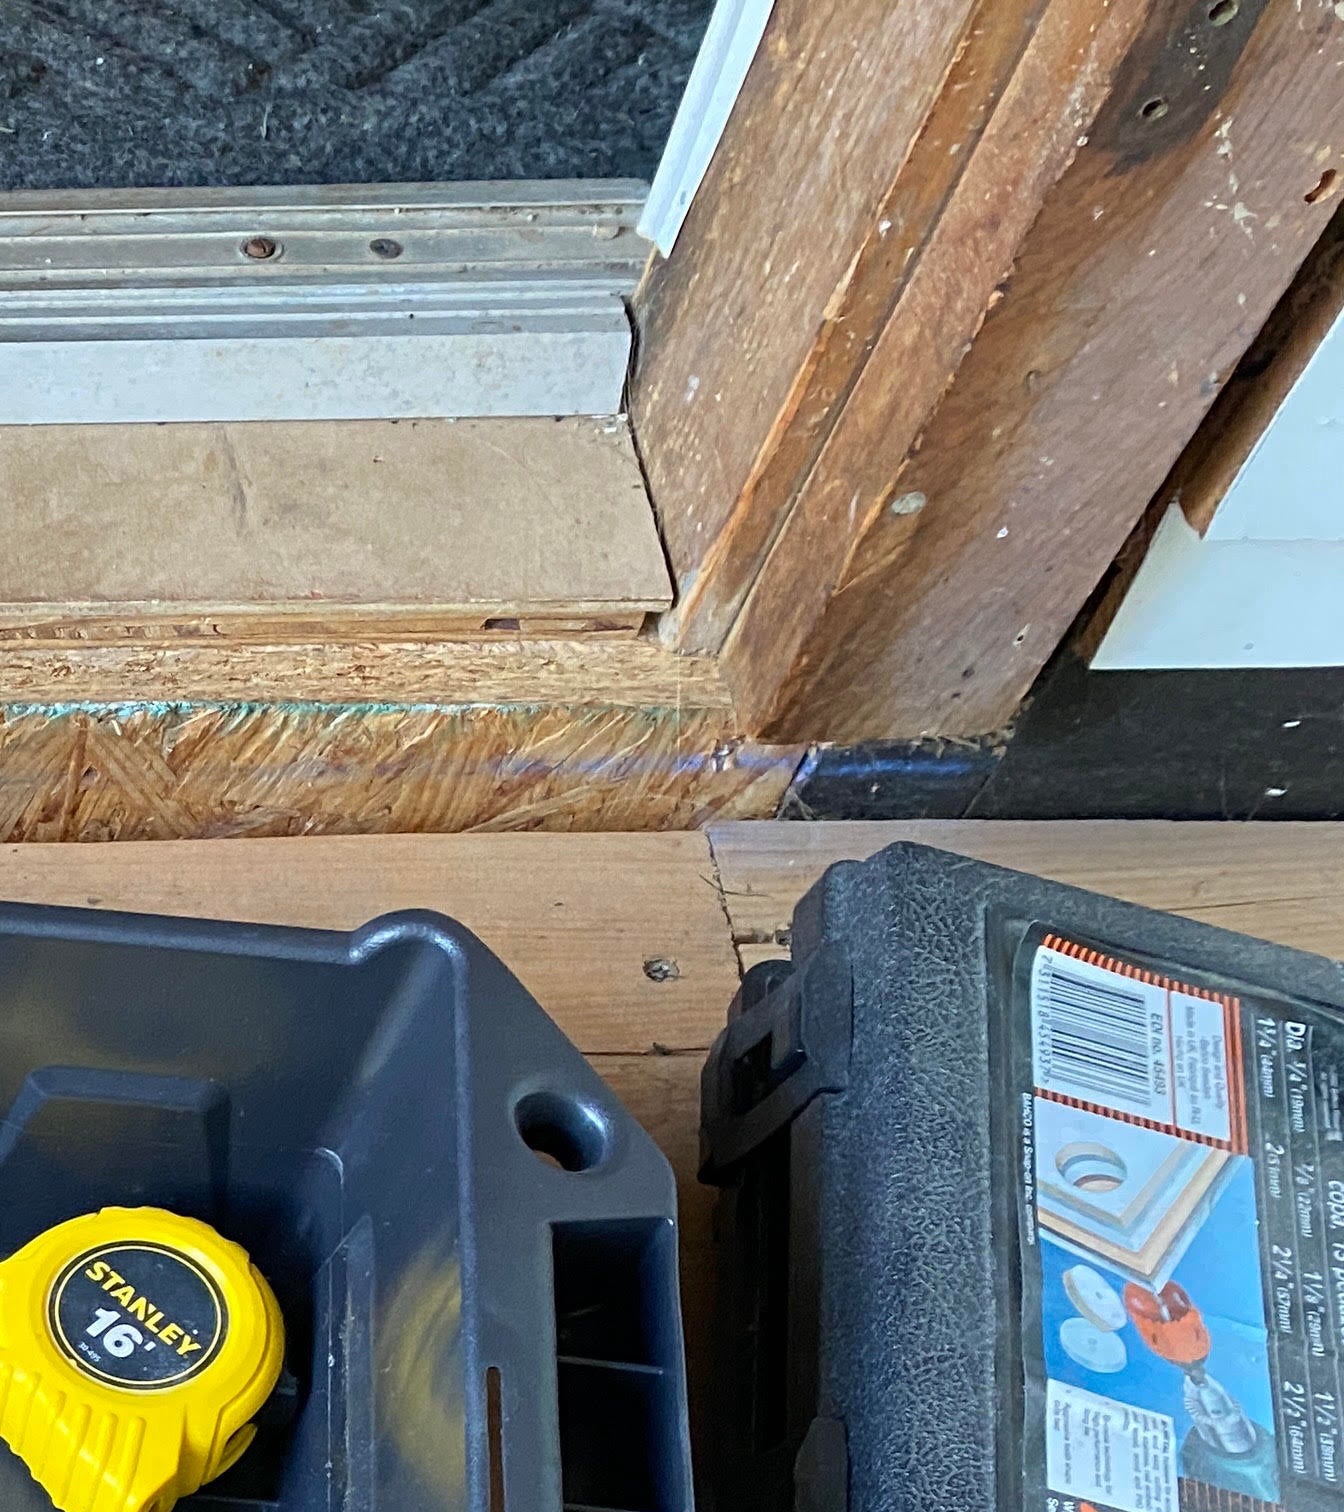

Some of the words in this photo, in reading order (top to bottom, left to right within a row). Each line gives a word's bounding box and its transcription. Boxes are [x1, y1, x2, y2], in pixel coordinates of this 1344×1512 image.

[1285, 1022, 1305, 1052] Dia.
[84, 1260, 201, 1357] STANLEY
[85, 1306, 155, 1359] 16'
